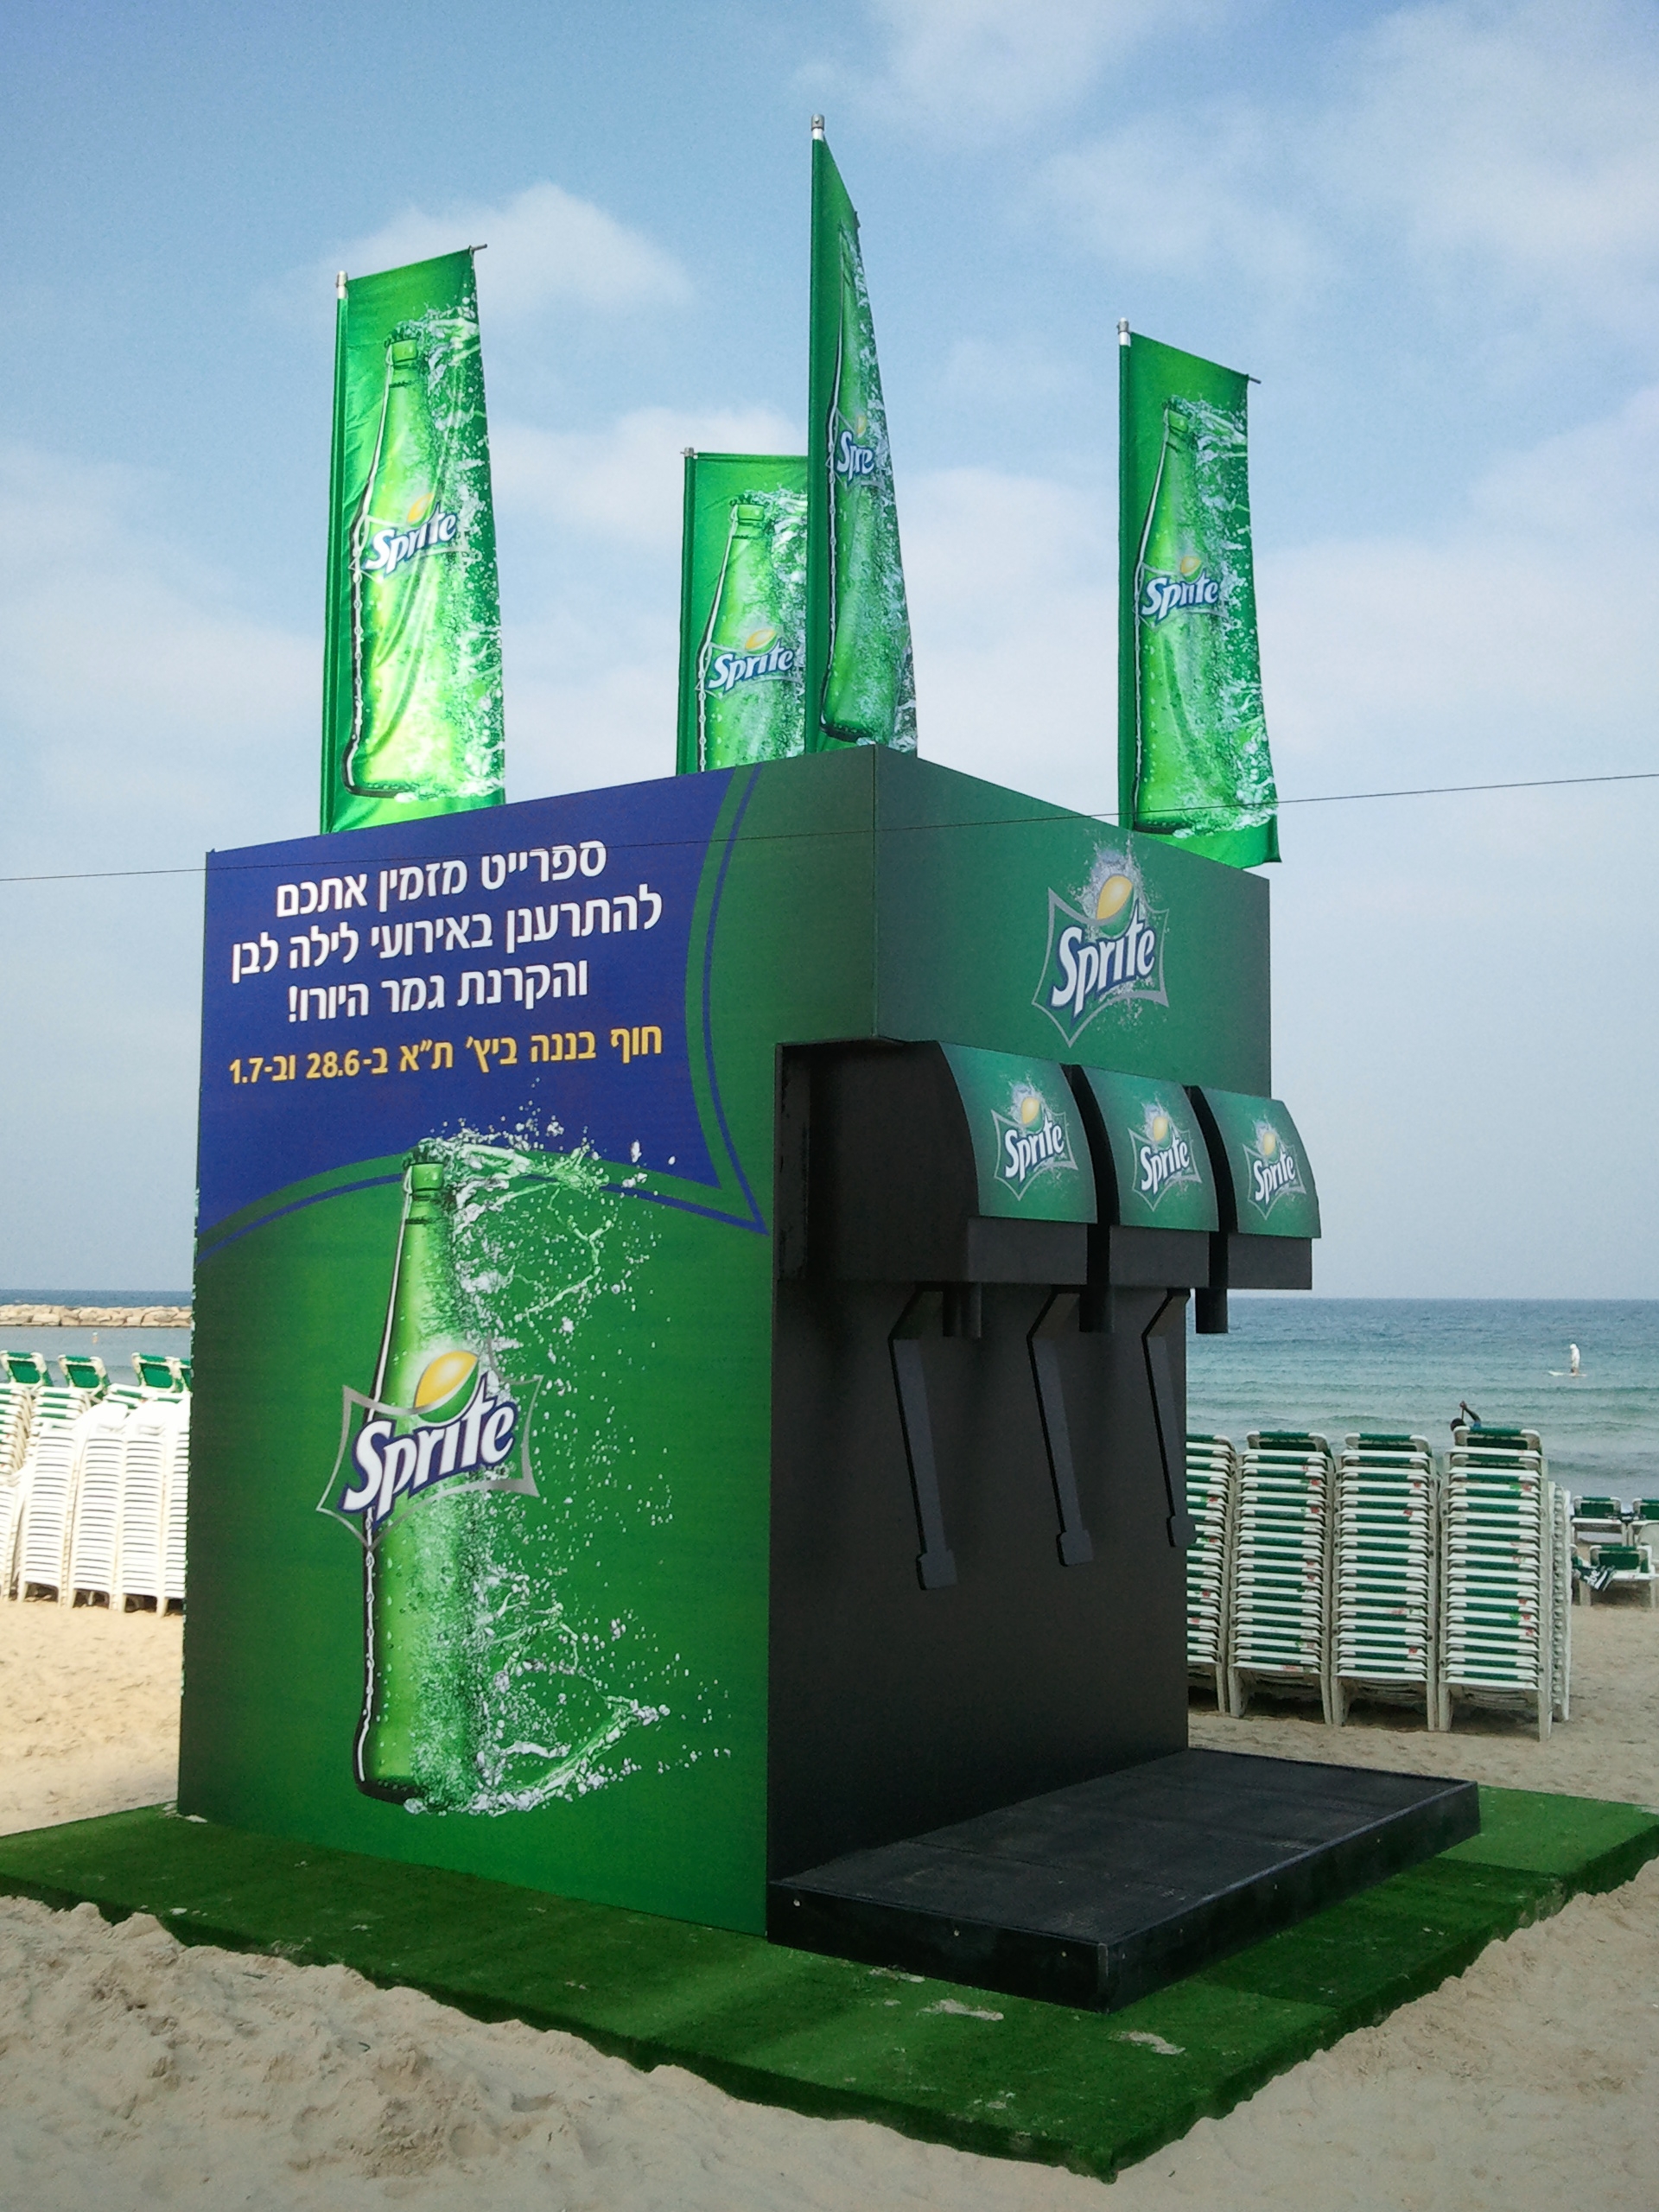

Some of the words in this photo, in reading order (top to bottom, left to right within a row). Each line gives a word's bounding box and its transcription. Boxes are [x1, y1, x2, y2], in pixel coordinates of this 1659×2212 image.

[363, 502, 458, 576] Sprite
[1141, 569, 1219, 625] Sprite
[706, 641, 794, 695] Sprite
[378, 860, 467, 912] מזמין
[481, 840, 607, 890] ספרייט
[276, 874, 368, 918] אתכם
[506, 883, 663, 954] להתרענן
[232, 931, 279, 984] לבן
[289, 921, 359, 969] לילה
[371, 913, 493, 959] באירועי
[1050, 899, 1157, 1025] Sprite
[289, 983, 369, 1023] היורו!
[380, 975, 445, 1013] גמר
[456, 960, 588, 1010] והקרנת
[531, 1031, 596, 1063] בננה
[610, 1026, 662, 1064] חוף
[1004, 1113, 1065, 1185] Sprite
[1140, 1135, 1190, 1195] Sprite
[1253, 1149, 1296, 1205] Sprite
[339, 1372, 518, 1530] Sprite
